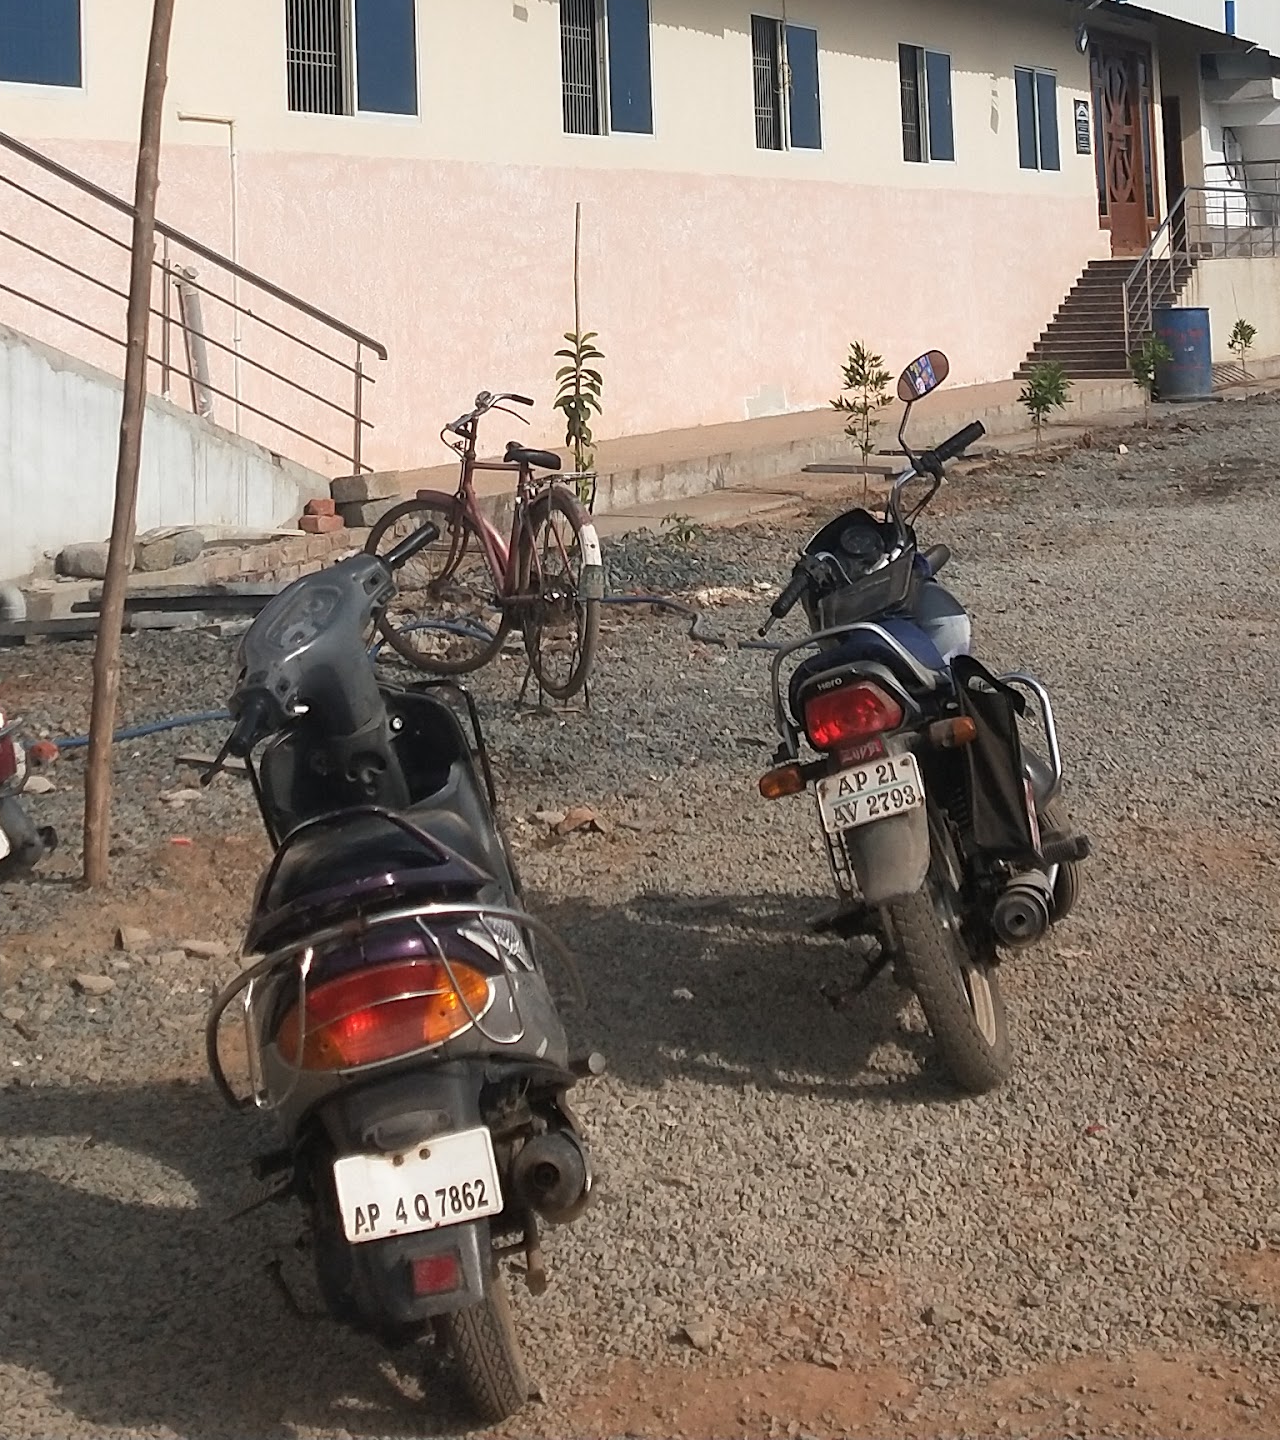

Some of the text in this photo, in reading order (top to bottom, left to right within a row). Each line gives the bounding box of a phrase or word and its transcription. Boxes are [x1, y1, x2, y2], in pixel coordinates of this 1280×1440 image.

[838, 761, 898, 797] AP 21
[866, 785, 916, 816] 2793
[395, 1197, 408, 1225] 4
[414, 1193, 432, 1223] Q
[435, 1179, 489, 1217] 7862
